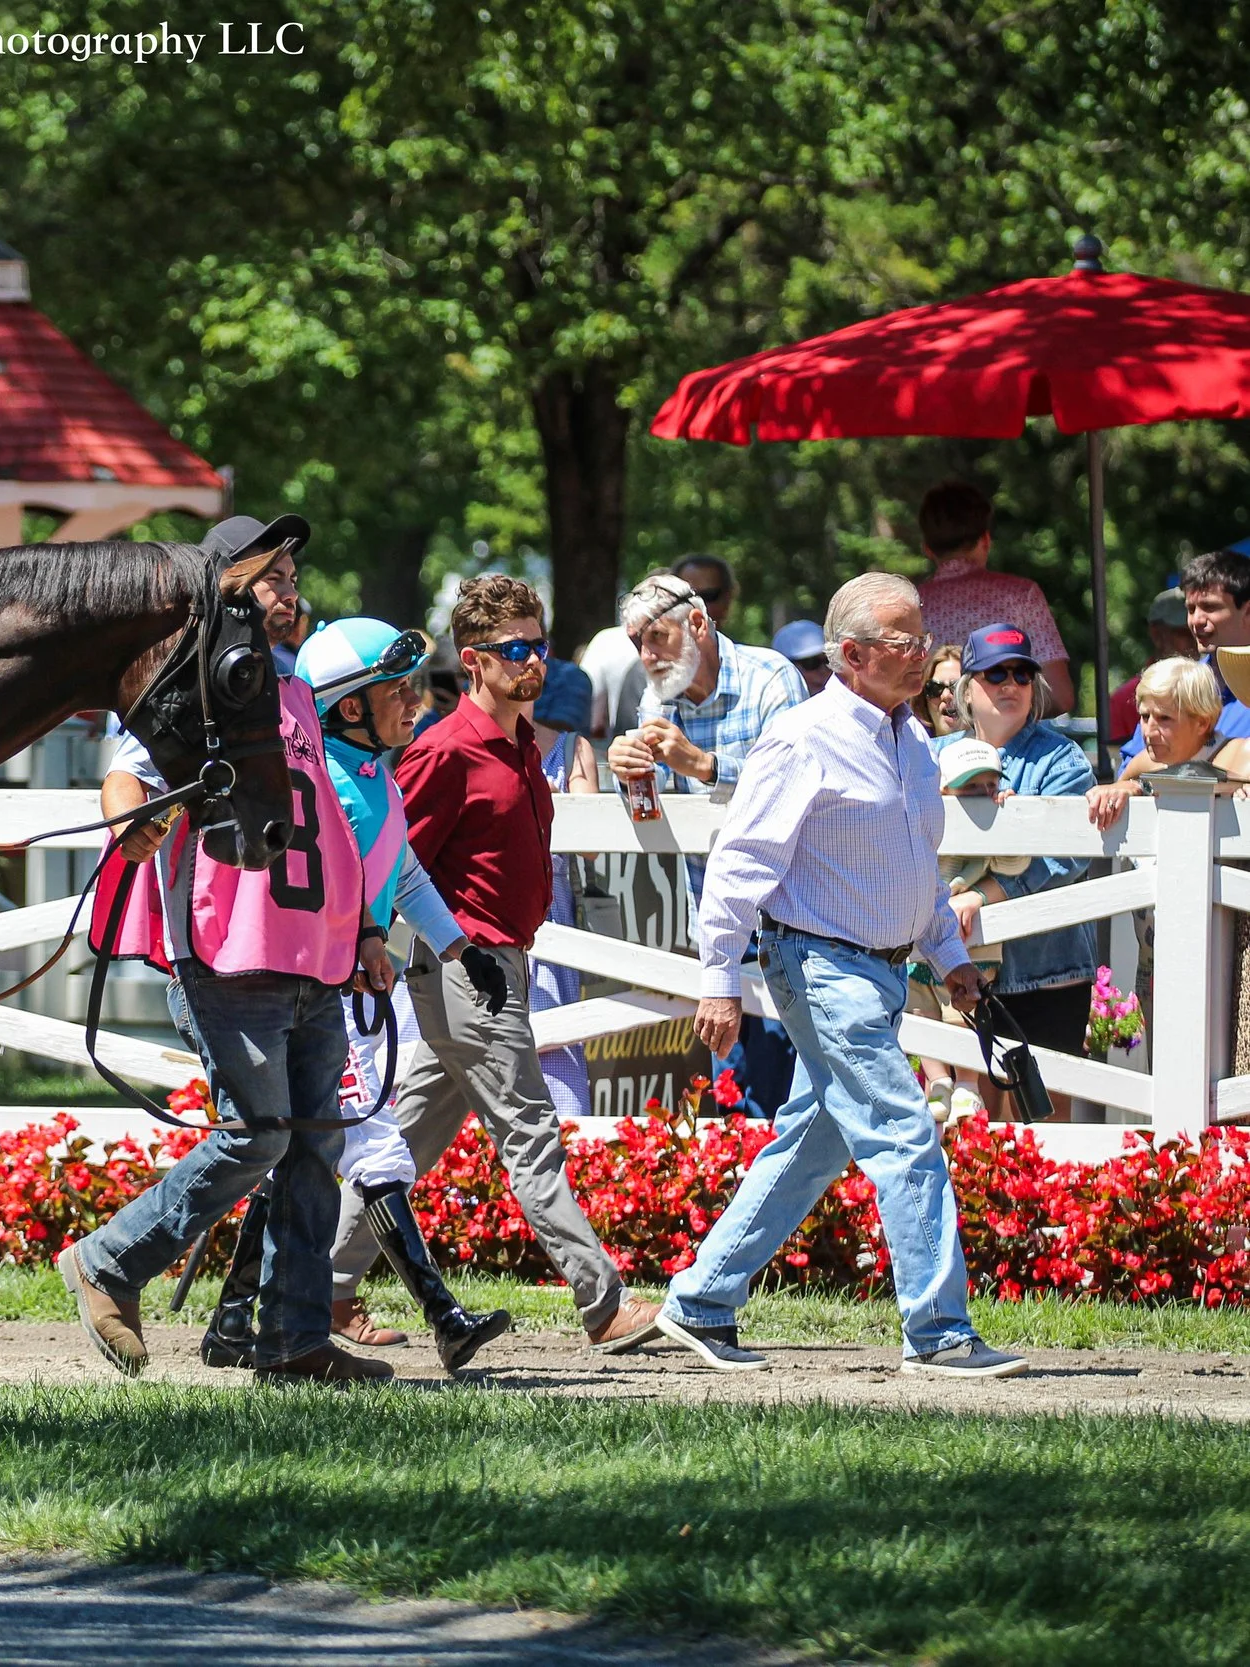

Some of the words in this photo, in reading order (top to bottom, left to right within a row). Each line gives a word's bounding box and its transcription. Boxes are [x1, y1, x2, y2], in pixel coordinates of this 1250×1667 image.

[284, 736, 320, 766] TOGA
[268, 768, 325, 914] 8
[593, 1072, 674, 1117] ODKA
